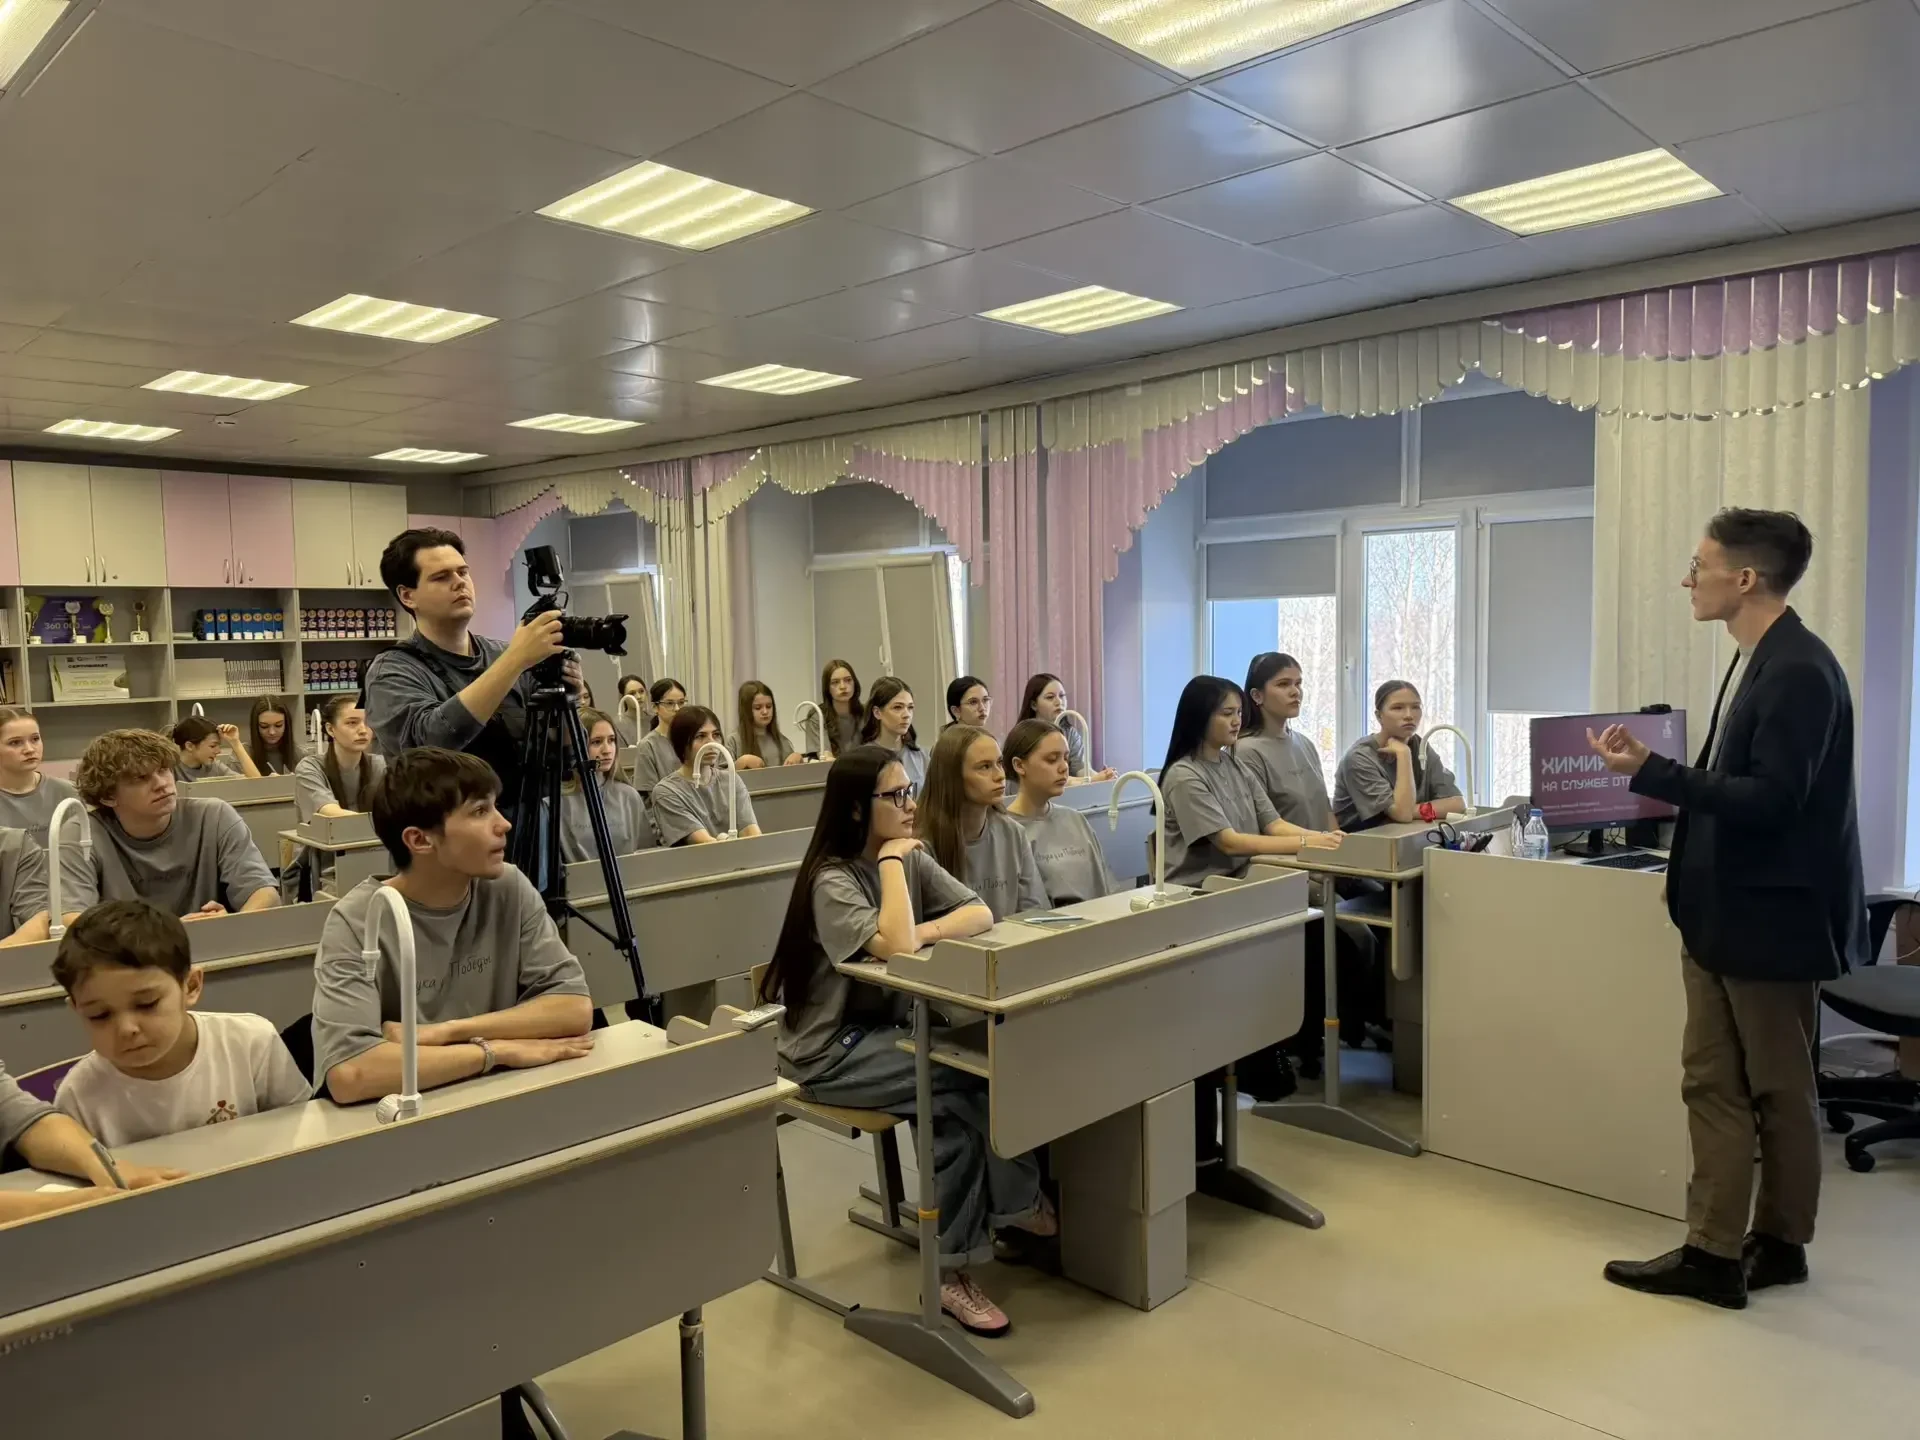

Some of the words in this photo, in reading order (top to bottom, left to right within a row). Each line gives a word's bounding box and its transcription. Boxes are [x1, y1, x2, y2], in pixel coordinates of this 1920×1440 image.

[1541, 781, 1558, 792] НА
[1561, 777, 1608, 790] СЛУЖБЕ
[449, 956, 492, 977] Победы
